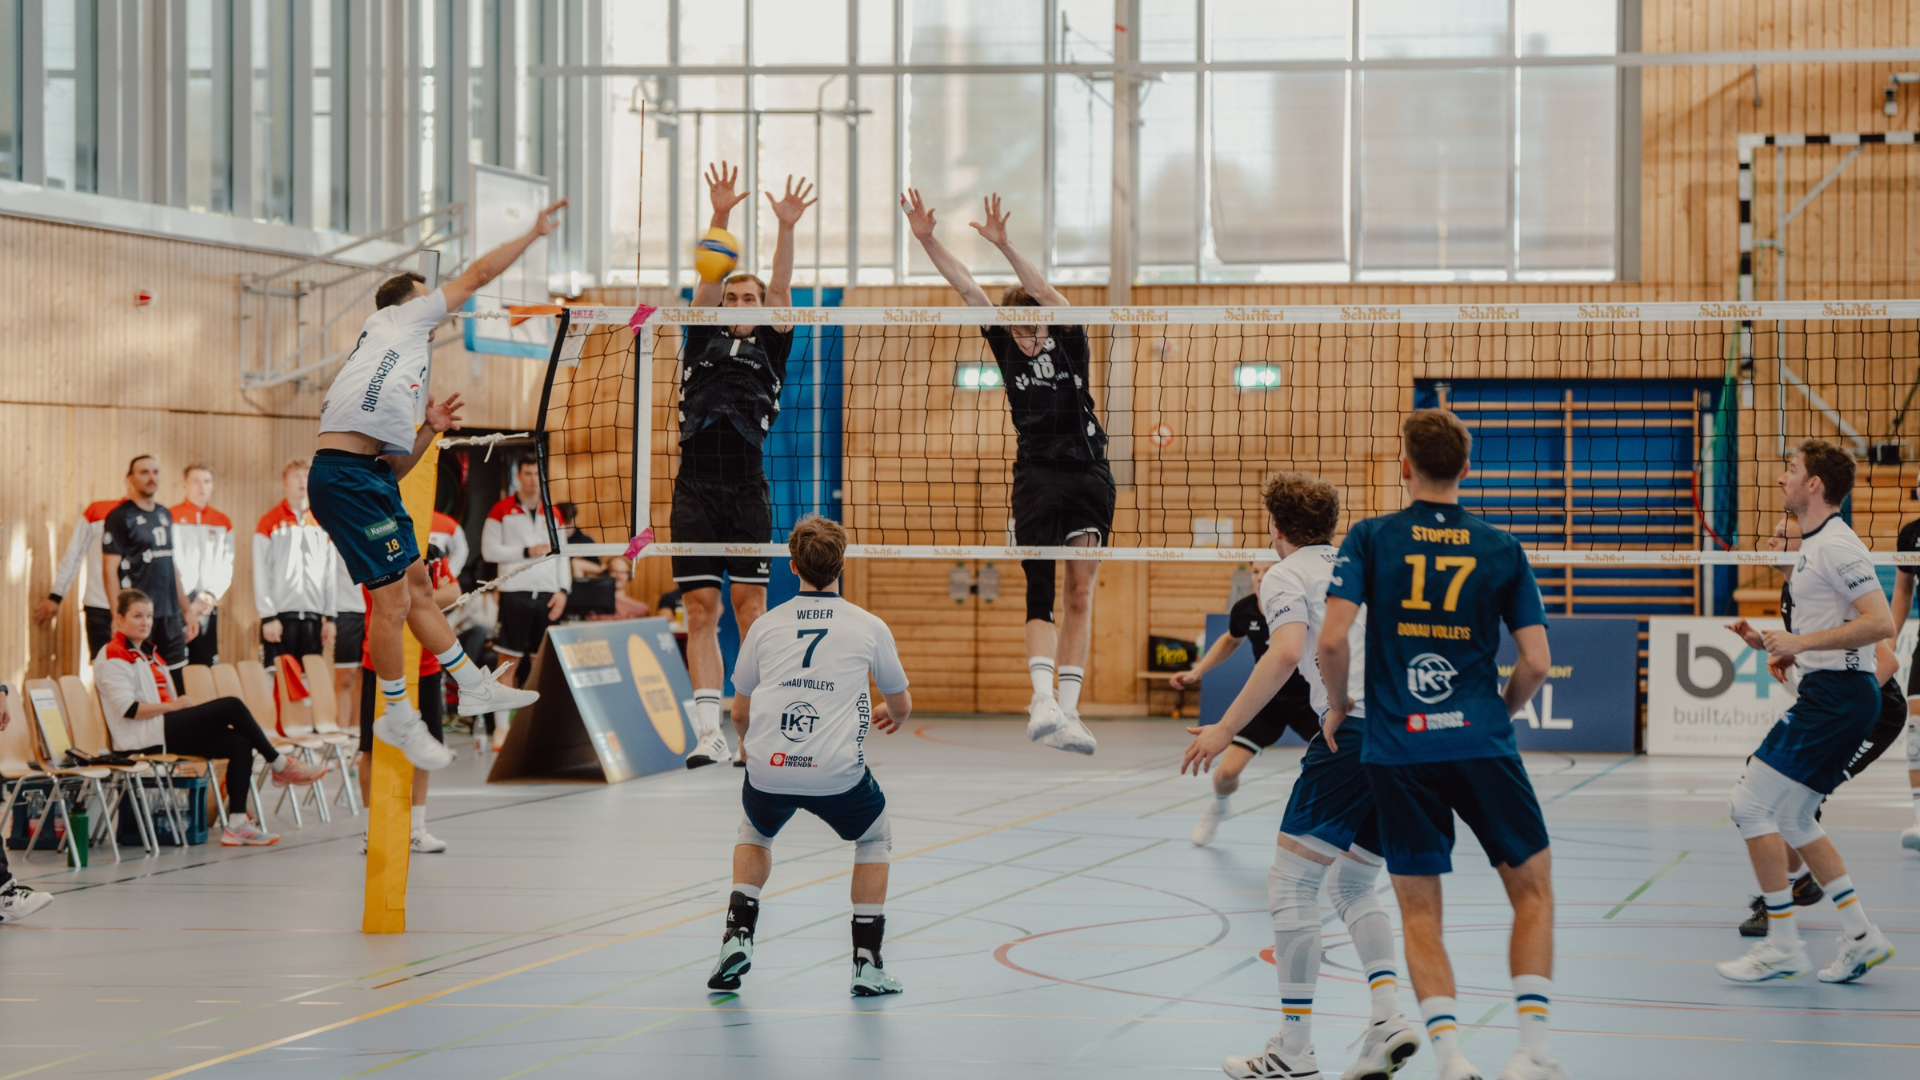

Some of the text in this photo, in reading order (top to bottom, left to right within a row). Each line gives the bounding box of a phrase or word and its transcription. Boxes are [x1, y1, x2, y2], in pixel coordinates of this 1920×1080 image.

[361, 349, 400, 412] REGENSBURG
[1411, 525, 1470, 545] STOPPER
[385, 538, 400, 553] 18
[1401, 554, 1477, 612] 17
[797, 609, 833, 620] WEBER
[1397, 622, 1471, 640] DONAU VOLLEYS
[797, 628, 828, 669] 7
[803, 679, 835, 691] VOLLEYS
